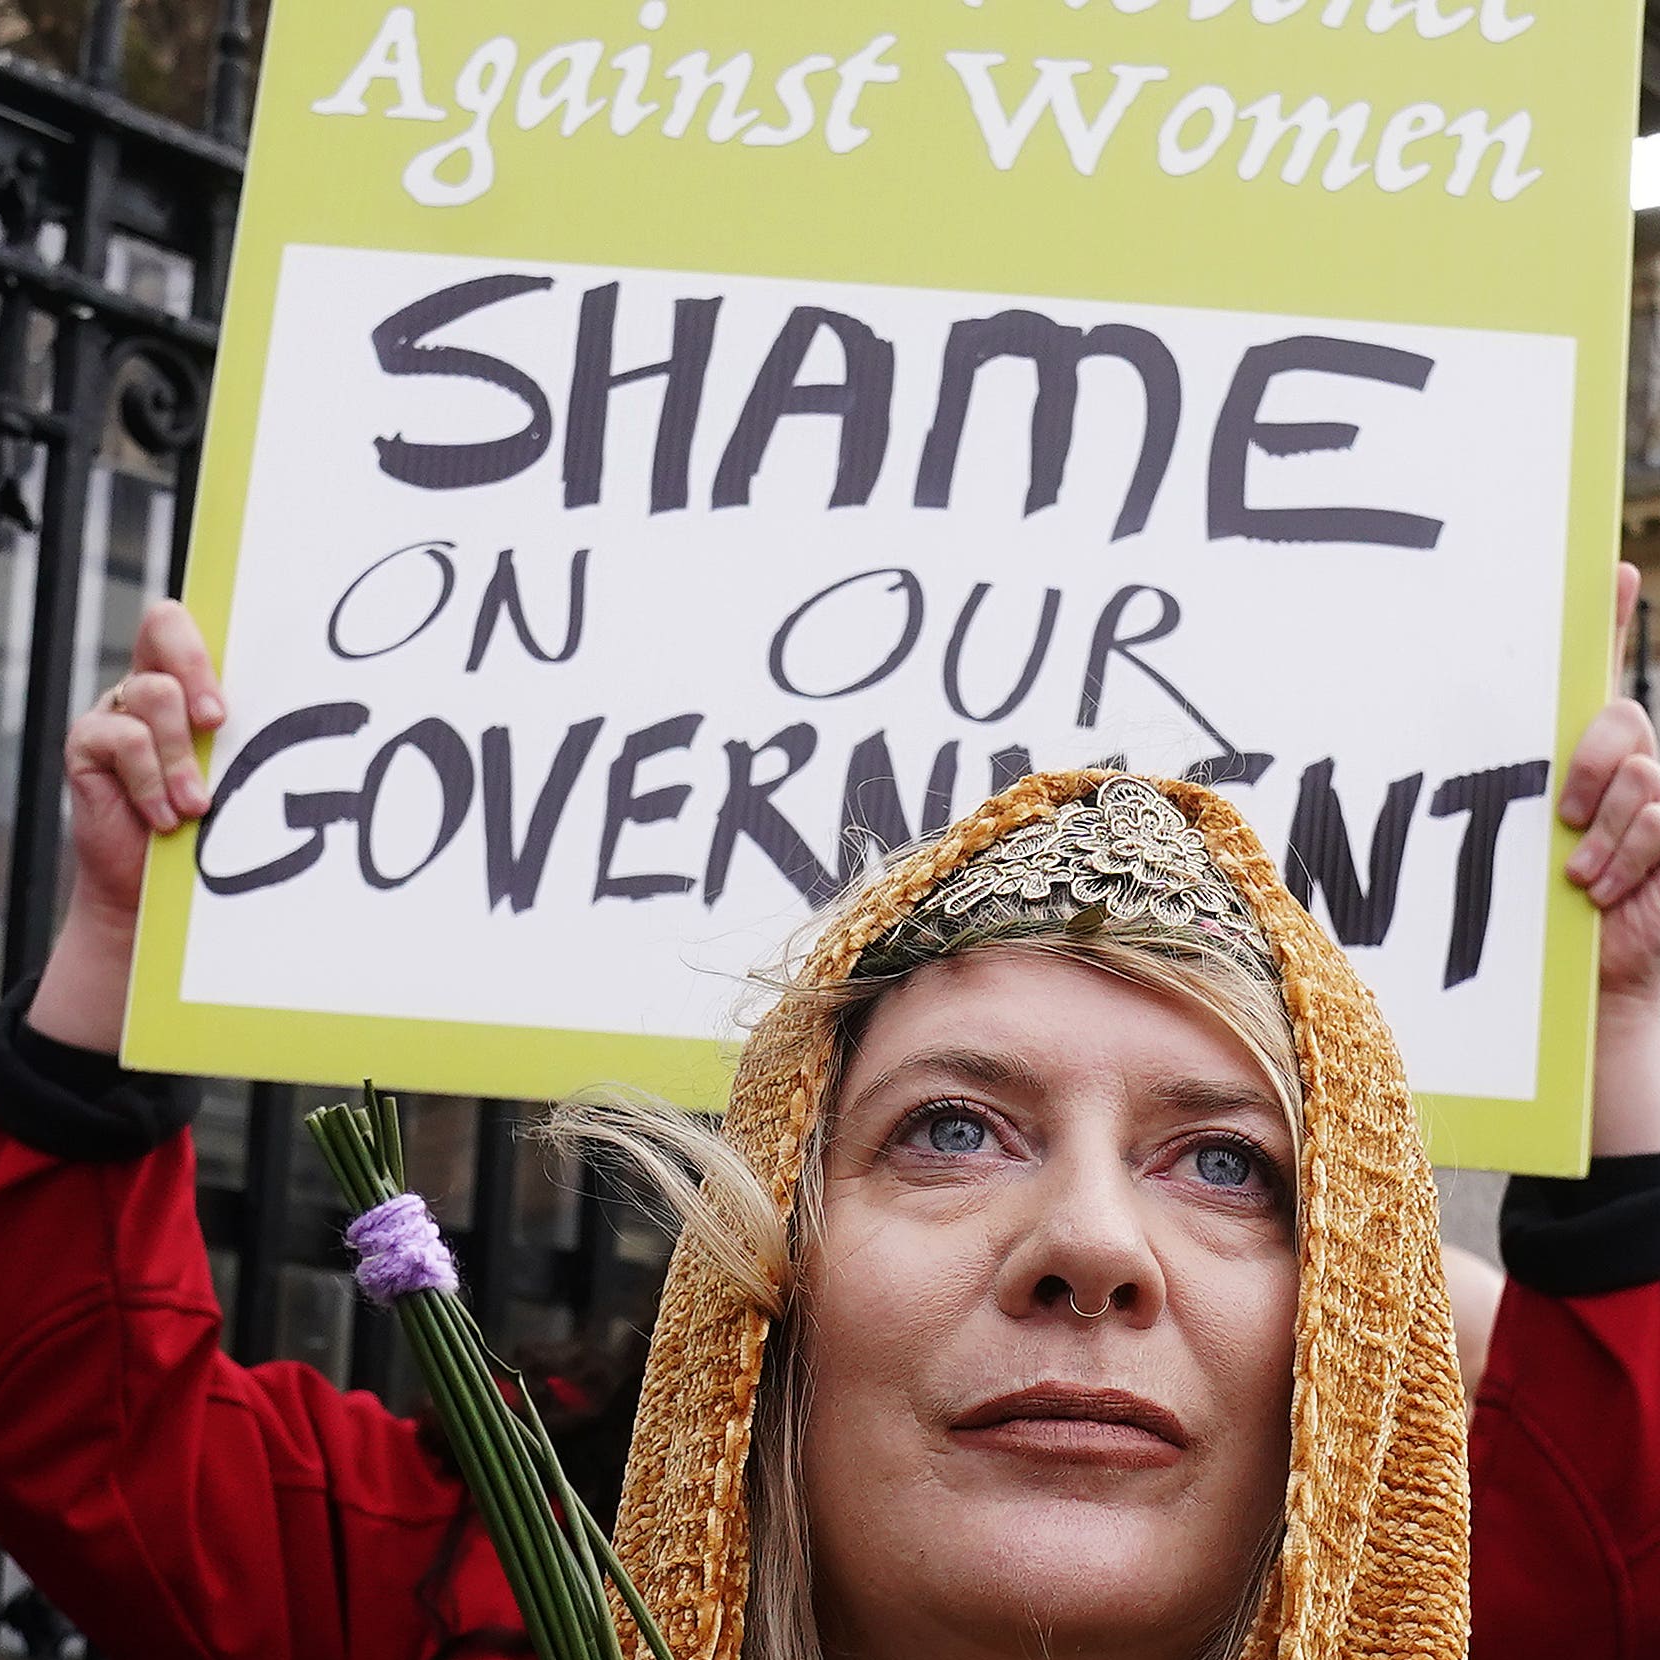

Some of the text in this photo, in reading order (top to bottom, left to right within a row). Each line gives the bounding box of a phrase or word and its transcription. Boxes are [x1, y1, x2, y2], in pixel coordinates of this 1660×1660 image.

[310, 0, 1546, 208] Against Women
[370, 273, 1446, 549] SHAME
[327, 540, 1245, 760] ON OUR
[196, 702, 1552, 990] GOVERNNT
